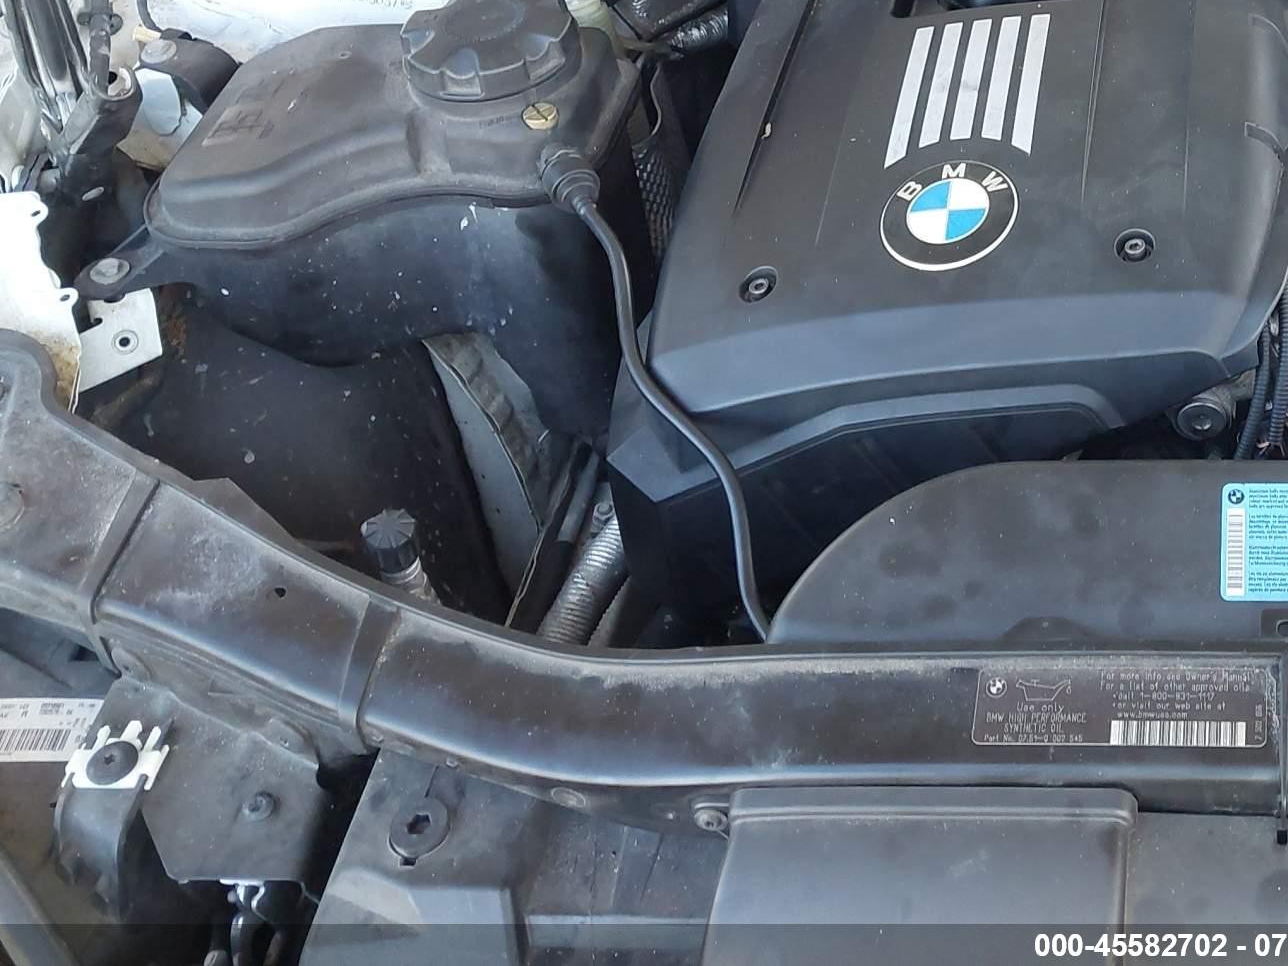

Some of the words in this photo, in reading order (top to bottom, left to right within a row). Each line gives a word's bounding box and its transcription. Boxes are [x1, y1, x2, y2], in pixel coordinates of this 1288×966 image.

[895, 162, 1009, 202] BMW
[1120, 672, 1140, 680] more
[1145, 670, 1162, 680] info
[1129, 681, 1144, 691] list
[1149, 681, 1159, 691] of
[1164, 681, 1186, 691] other
[1191, 681, 1229, 693] approved
[1016, 702, 1035, 712] Use
[1041, 701, 1065, 715] only
[1131, 700, 1151, 710] visit
[1156, 702, 1170, 710] our
[1174, 701, 1191, 711] web
[1195, 701, 1212, 711] site
[1216, 701, 1226, 711] at
[986, 712, 1004, 723] BMW
[1008, 712, 1027, 723] HIGH
[1031, 712, 1087, 723] PERFORMANCE
[1003, 722, 1047, 733] SYNTHETIC
[1050, 722, 1064, 733] OIL
[984, 733, 999, 742] Part
